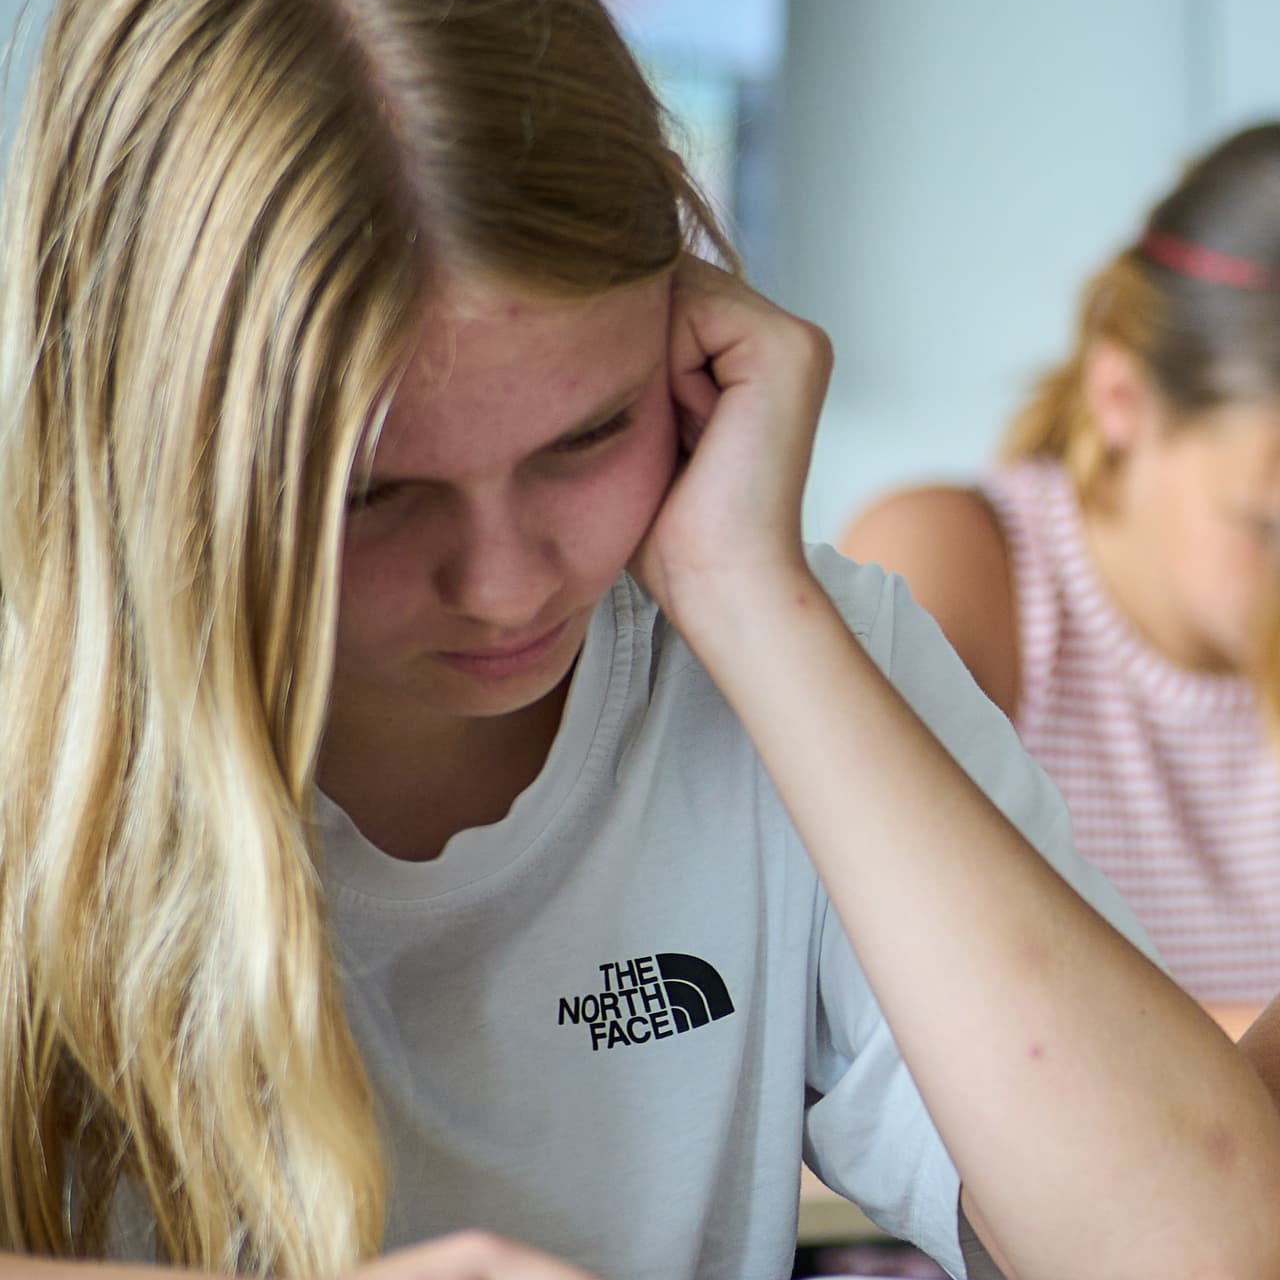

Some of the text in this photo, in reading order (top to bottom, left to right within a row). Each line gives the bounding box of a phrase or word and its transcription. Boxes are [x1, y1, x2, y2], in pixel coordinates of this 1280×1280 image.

[599, 956, 658, 991] THE
[558, 983, 667, 1025] NORTH
[590, 1010, 674, 1051] FACE
